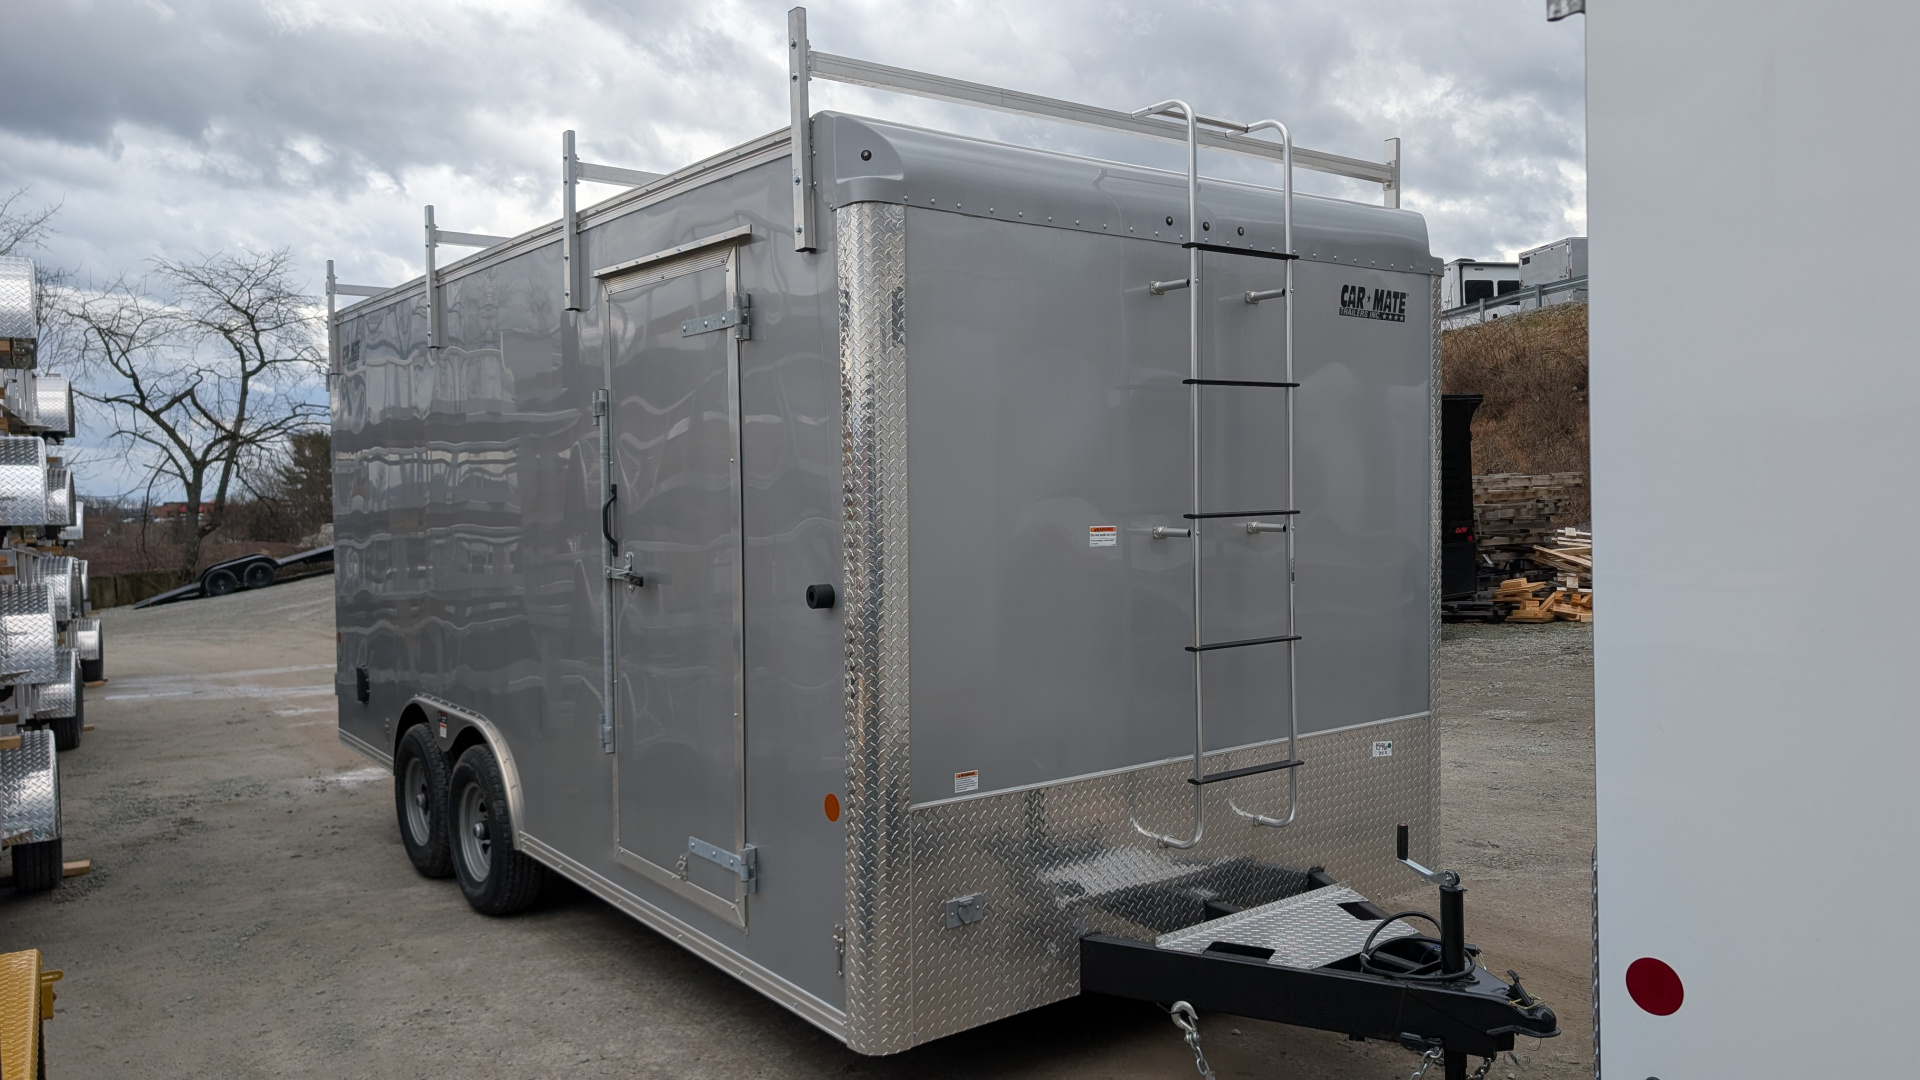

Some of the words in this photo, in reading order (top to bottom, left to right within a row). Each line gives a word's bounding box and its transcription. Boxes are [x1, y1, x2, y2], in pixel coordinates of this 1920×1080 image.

[1340, 284, 1366, 309] CAR
[1373, 288, 1406, 314] MATE
[1340, 307, 1369, 318] TRAILERS
